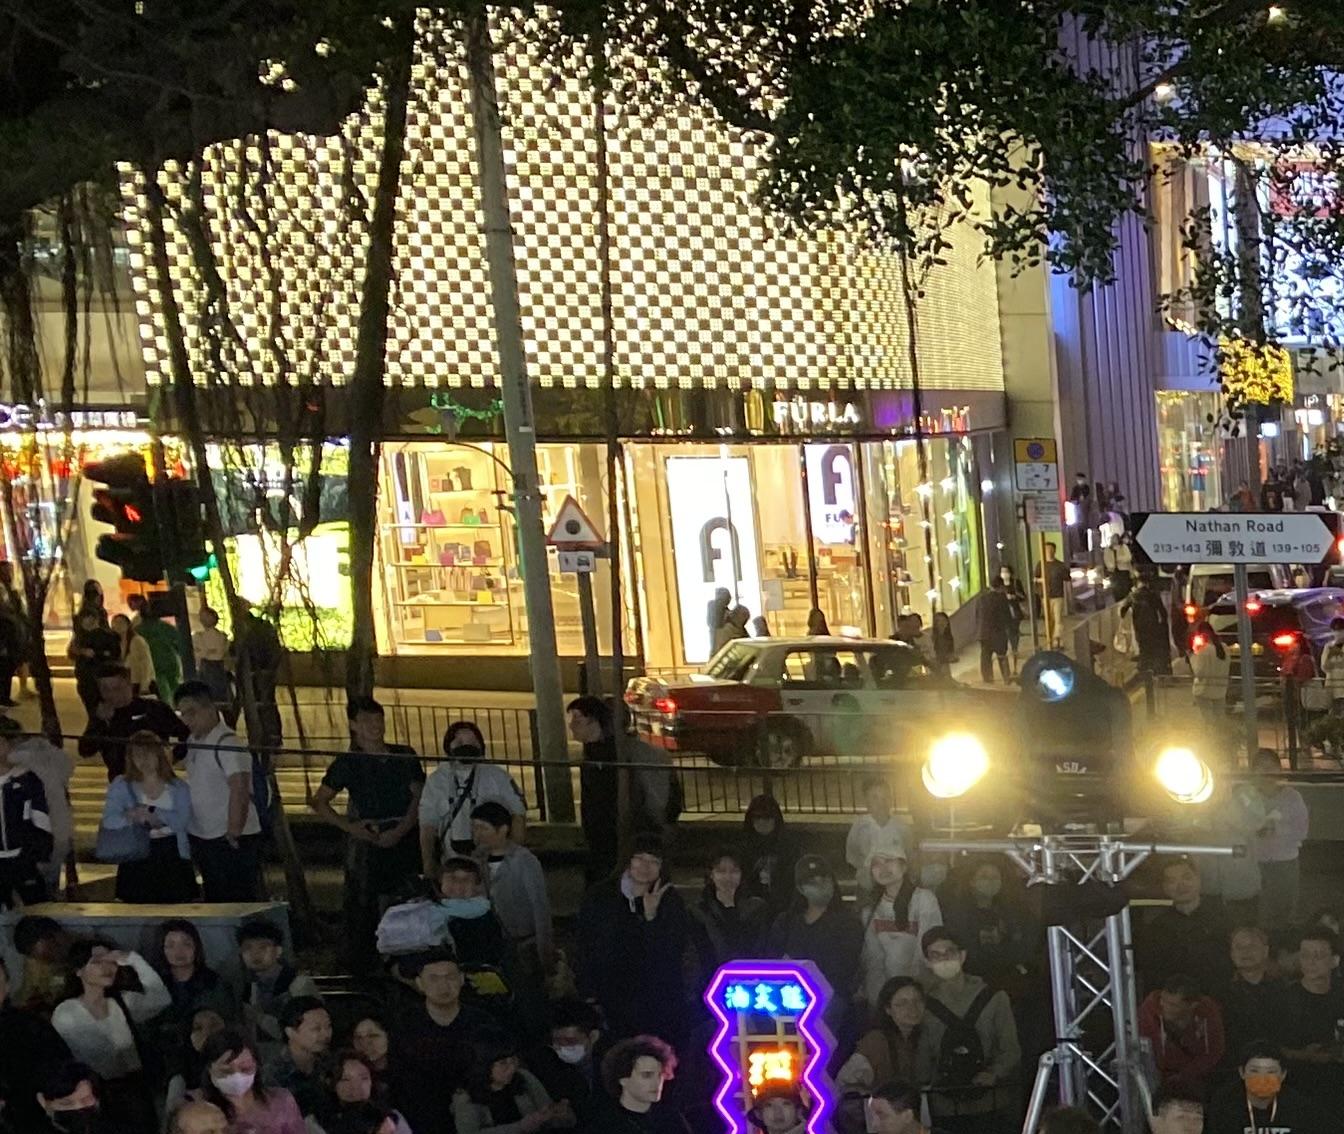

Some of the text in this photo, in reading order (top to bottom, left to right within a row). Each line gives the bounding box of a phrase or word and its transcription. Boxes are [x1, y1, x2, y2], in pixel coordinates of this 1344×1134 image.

[772, 401, 860, 423] FURLA
[1185, 519, 1284, 533] Nathan Road
[1205, 539, 1268, 557] 彌敦道
